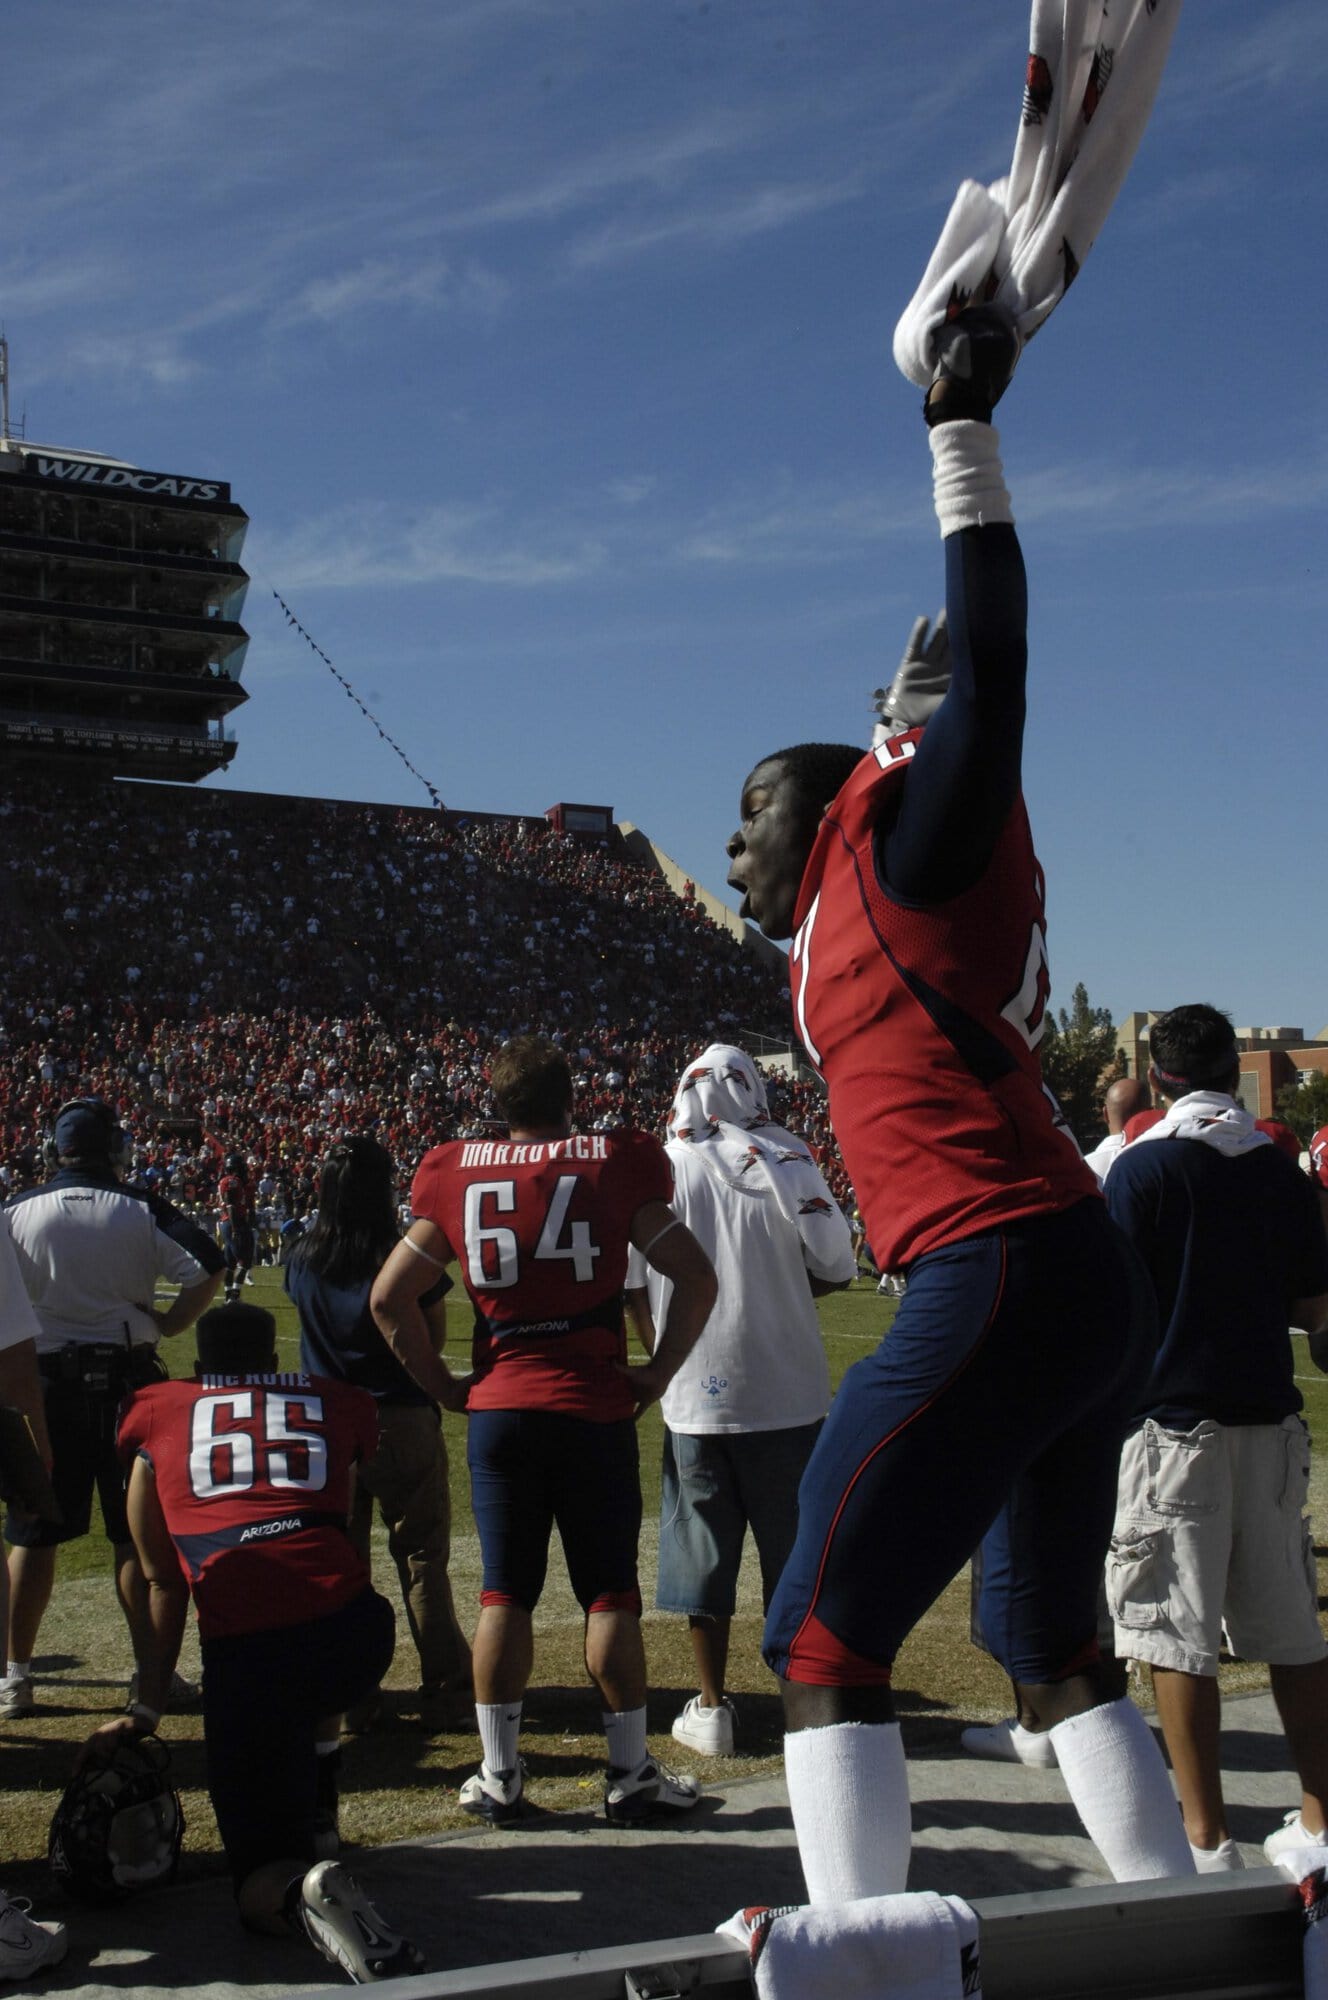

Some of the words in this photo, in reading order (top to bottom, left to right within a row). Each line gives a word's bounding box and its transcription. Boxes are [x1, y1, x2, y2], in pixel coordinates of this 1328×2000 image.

[37, 458, 221, 500] WILDCATS
[460, 1135, 608, 1168] MARKOVICH
[464, 1175, 601, 1289] 64
[516, 1319, 571, 1334] ARIZONA
[189, 1391, 328, 1498] 65
[239, 1517, 302, 1542] ARIZONA
